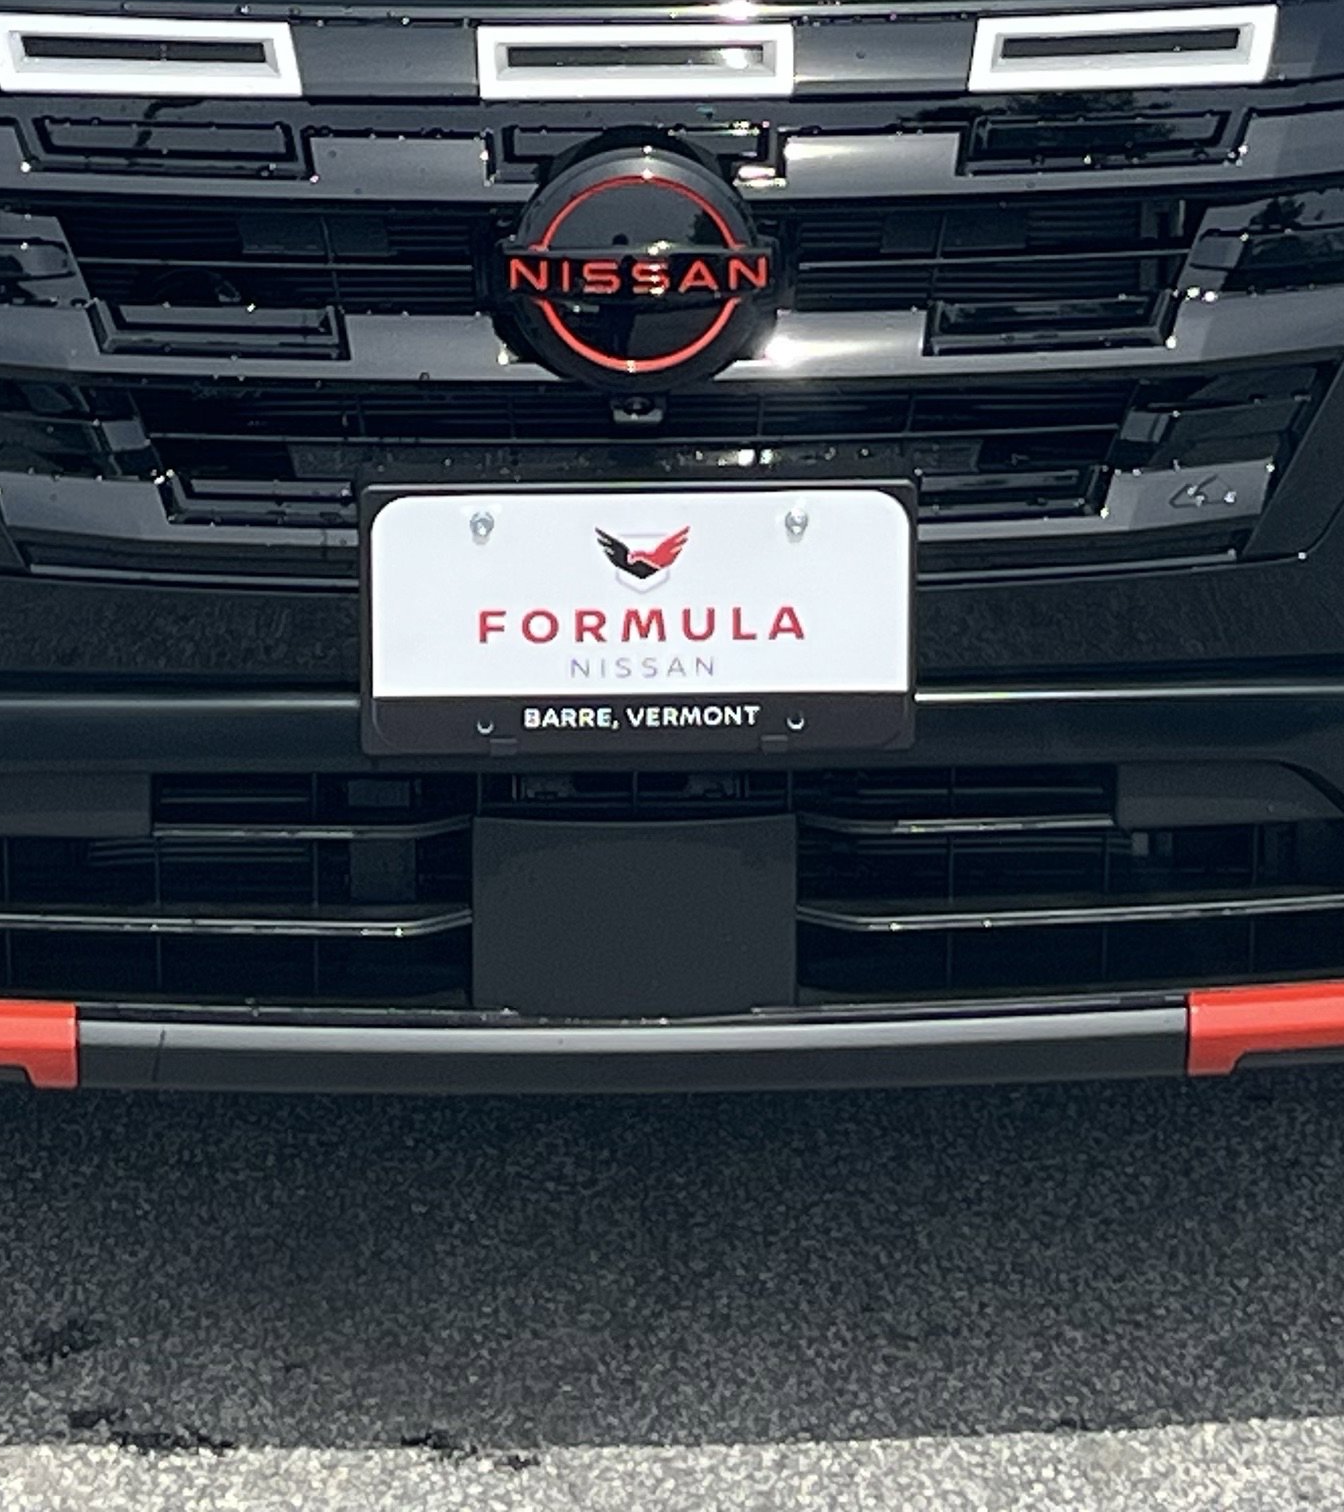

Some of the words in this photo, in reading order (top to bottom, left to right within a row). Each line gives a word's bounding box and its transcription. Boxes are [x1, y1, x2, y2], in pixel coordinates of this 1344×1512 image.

[509, 256, 768, 295] NISSAN
[478, 606, 805, 644] FORMULA
[570, 656, 715, 679] NISSAN
[524, 707, 620, 730] BARRE,
[626, 705, 761, 727] VERMONT
